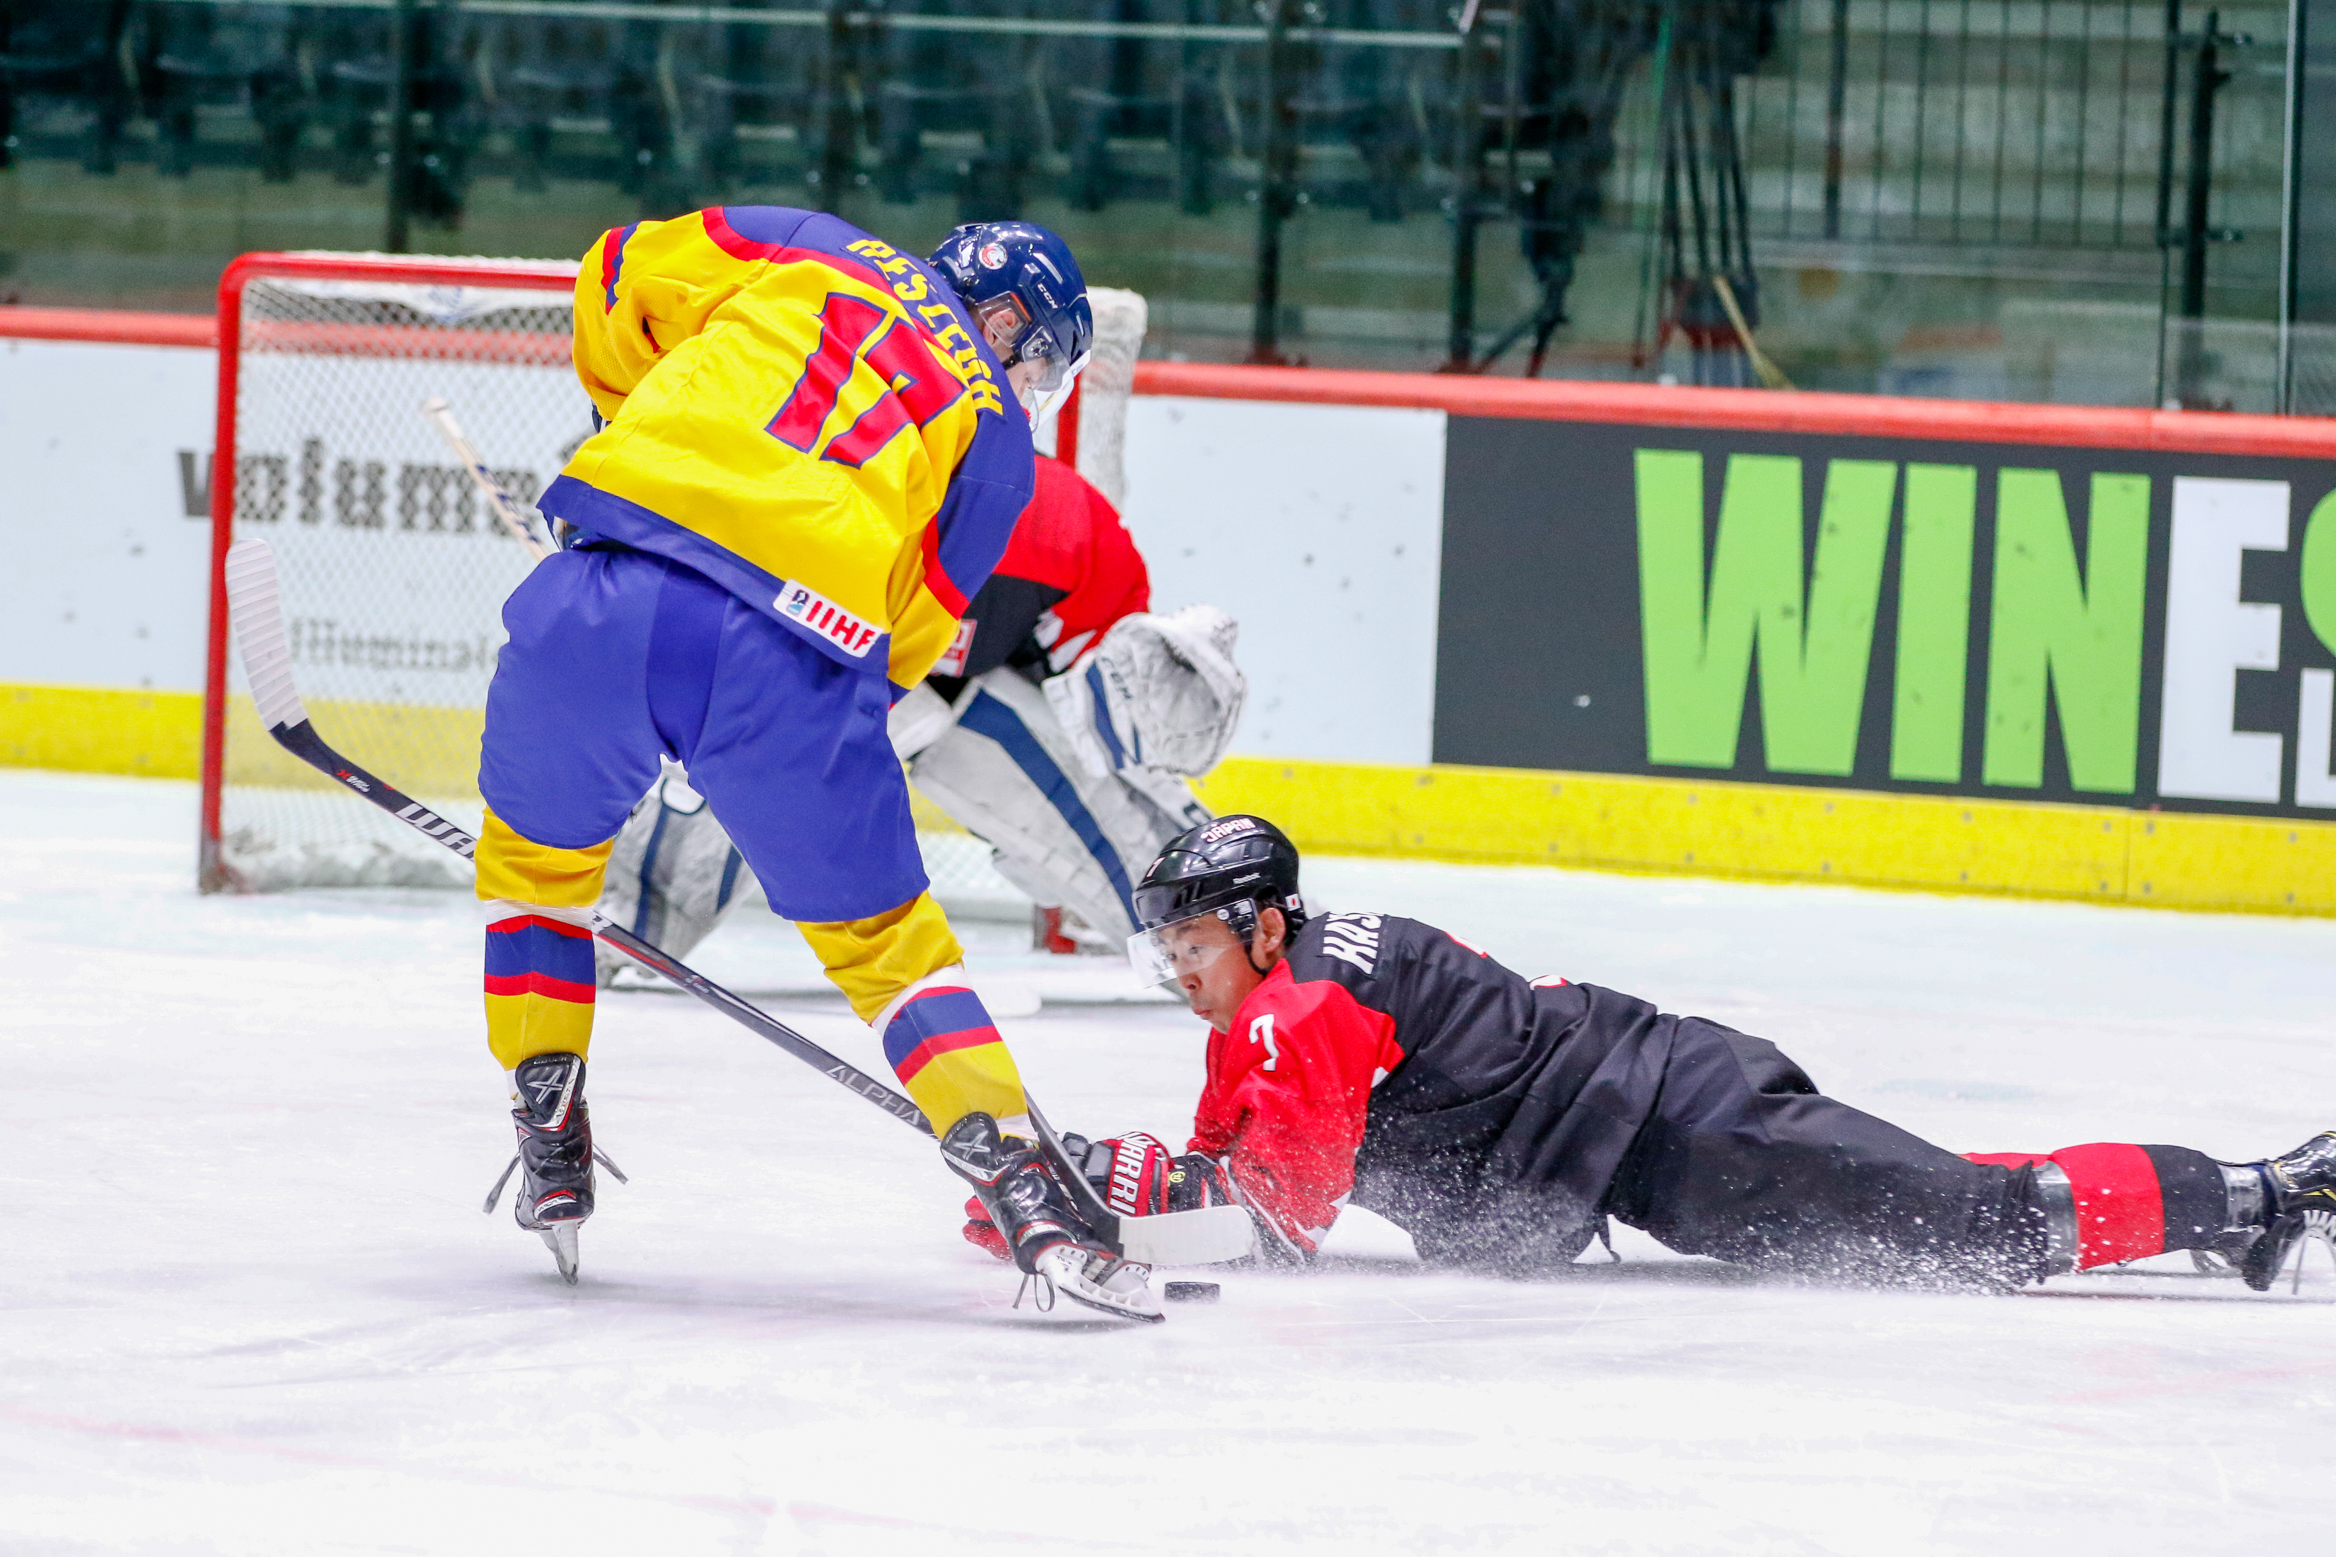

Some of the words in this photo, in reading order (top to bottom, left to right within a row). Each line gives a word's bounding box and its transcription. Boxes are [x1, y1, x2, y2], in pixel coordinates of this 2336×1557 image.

[1037, 282, 1059, 309] CCM
[763, 291, 969, 471] 17
[806, 600, 876, 652] IIHF
[1634, 448, 2336, 804] WINE
[395, 803, 478, 861] WA
[1203, 818, 1256, 844] JAPAN
[1322, 911, 1385, 975] HAS
[1249, 1013, 1280, 1072] 7
[825, 1064, 921, 1126] ALPHA
[1108, 1131, 1157, 1217] WARRI
